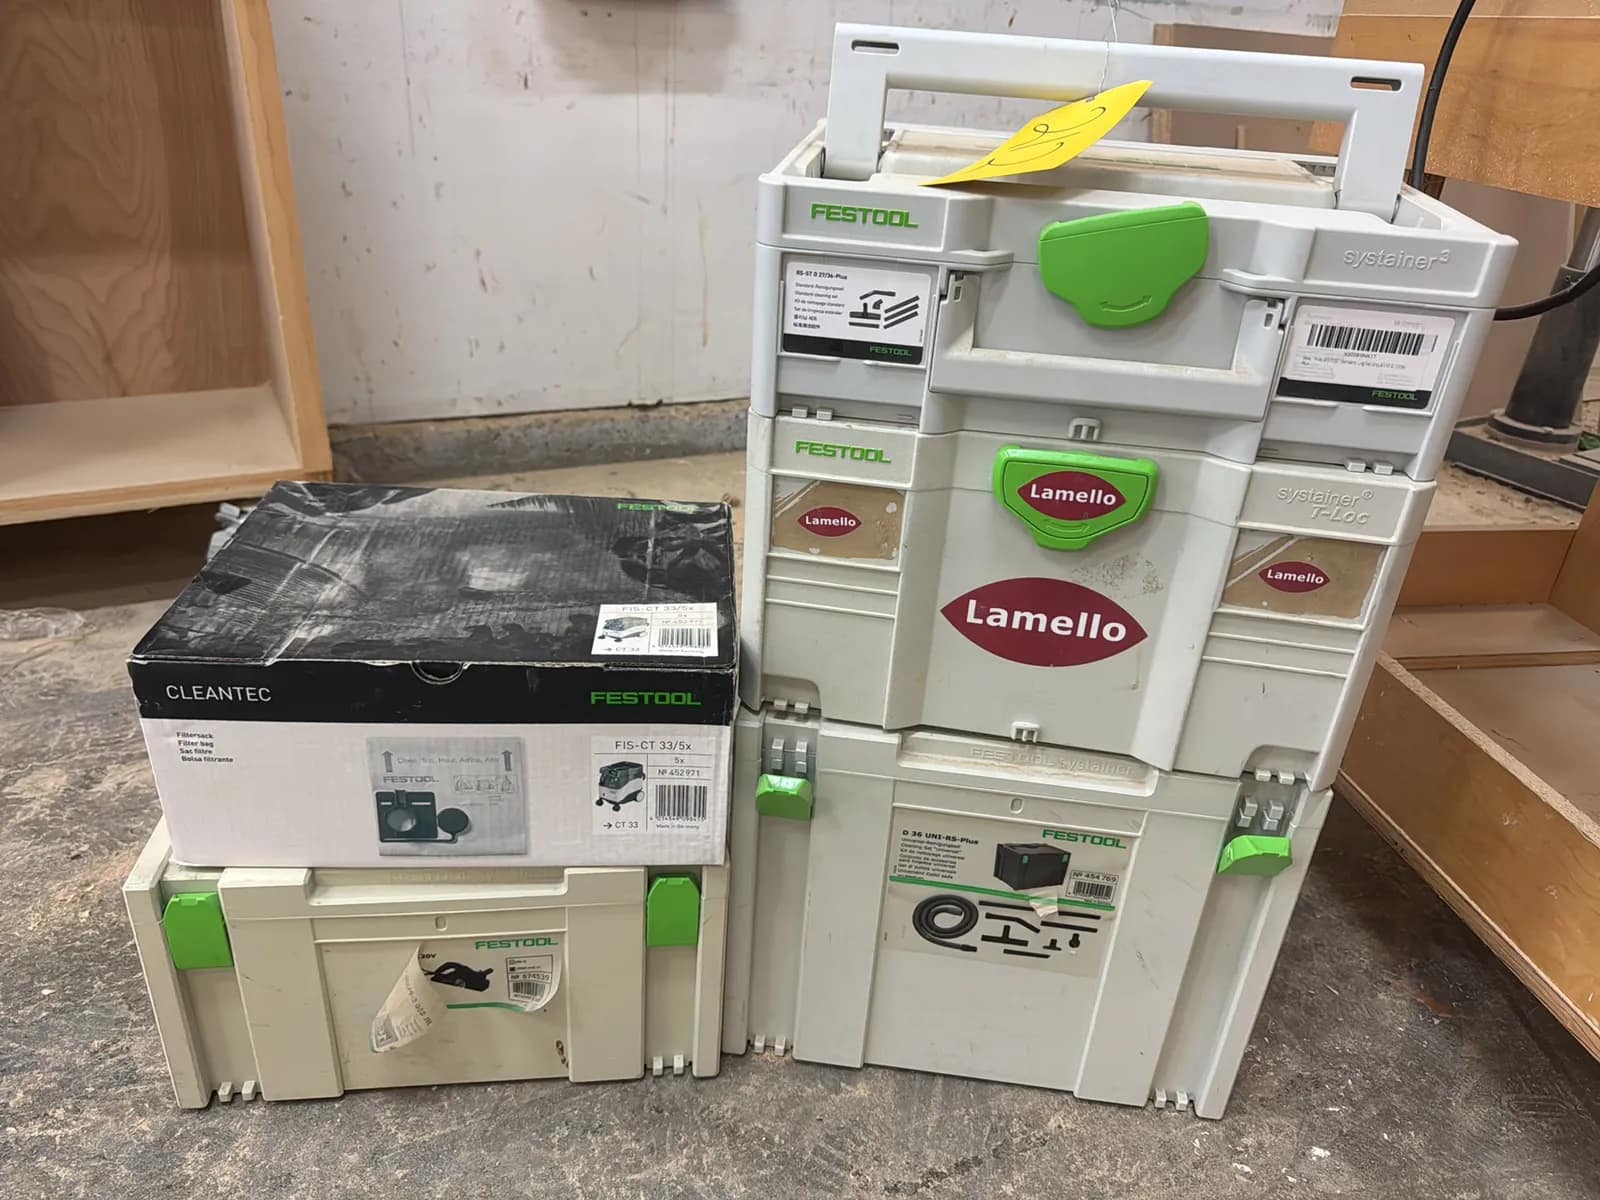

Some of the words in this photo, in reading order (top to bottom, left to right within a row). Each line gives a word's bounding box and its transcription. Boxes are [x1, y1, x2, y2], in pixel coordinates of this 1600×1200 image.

[810, 203, 919, 229] FESTOOL
[869, 345, 913, 357] FESTOOL
[1371, 389, 1418, 401] FESTOOL
[795, 440, 892, 464] FESTOOL
[1030, 483, 1117, 506] Lamello
[805, 515, 856, 527] Lamello
[1266, 569, 1325, 585] Lamello
[965, 599, 1127, 643] Lamello
[166, 684, 272, 702] CLEANTEC
[590, 691, 702, 705] FESTOOL
[176, 731, 213, 739] Filtersack
[615, 740, 656, 750] FIS-CT
[659, 740, 692, 750] 33/5x
[674, 756, 685, 764] 5x
[383, 775, 440, 784] FESTOOL
[615, 821, 625, 829] CT
[628, 821, 639, 829] 33
[911, 830, 923, 838] 36
[1042, 829, 1127, 849] FESTOOL
[475, 937, 559, 951] FESTOOL
